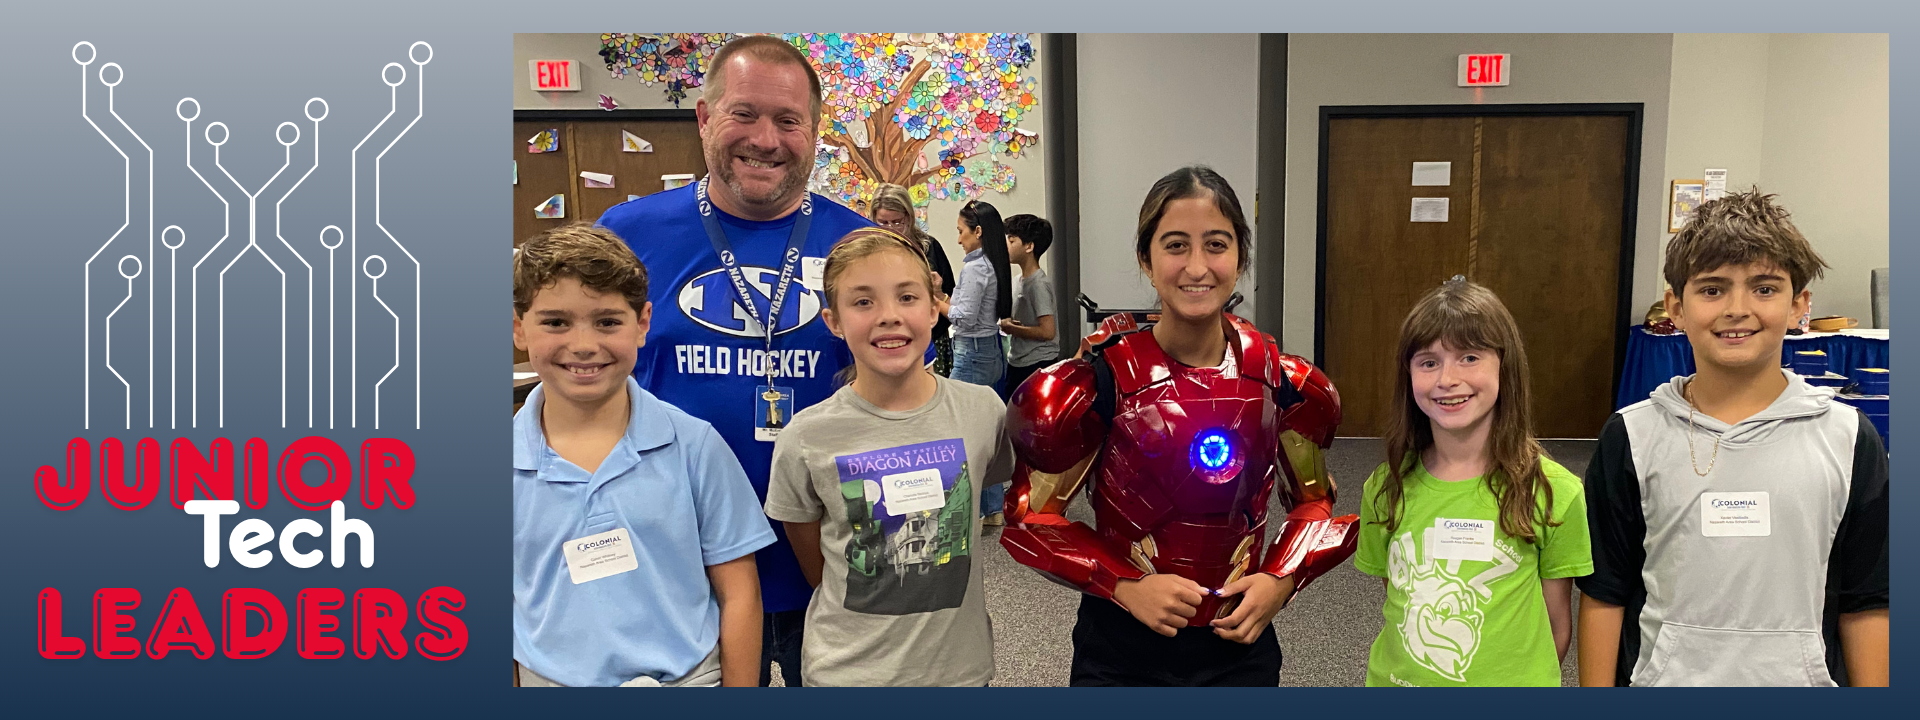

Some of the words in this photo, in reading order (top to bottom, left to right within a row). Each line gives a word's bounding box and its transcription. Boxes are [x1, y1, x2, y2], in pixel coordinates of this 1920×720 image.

[537, 61, 570, 88] EXIT
[1467, 55, 1503, 83] EXIT
[729, 267, 759, 319] NAZARETH
[772, 264, 794, 315] NAZARETH
[675, 345, 731, 374] FIELD
[848, 452, 897, 463] EXPLORE
[904, 444, 956, 455] MYSTICAL
[848, 455, 911, 476] DIAGON
[915, 449, 956, 466] ALLEY
[902, 477, 934, 486] COLONIAL
[585, 536, 622, 549] COLONIAL
[1495, 539, 1523, 564] School
